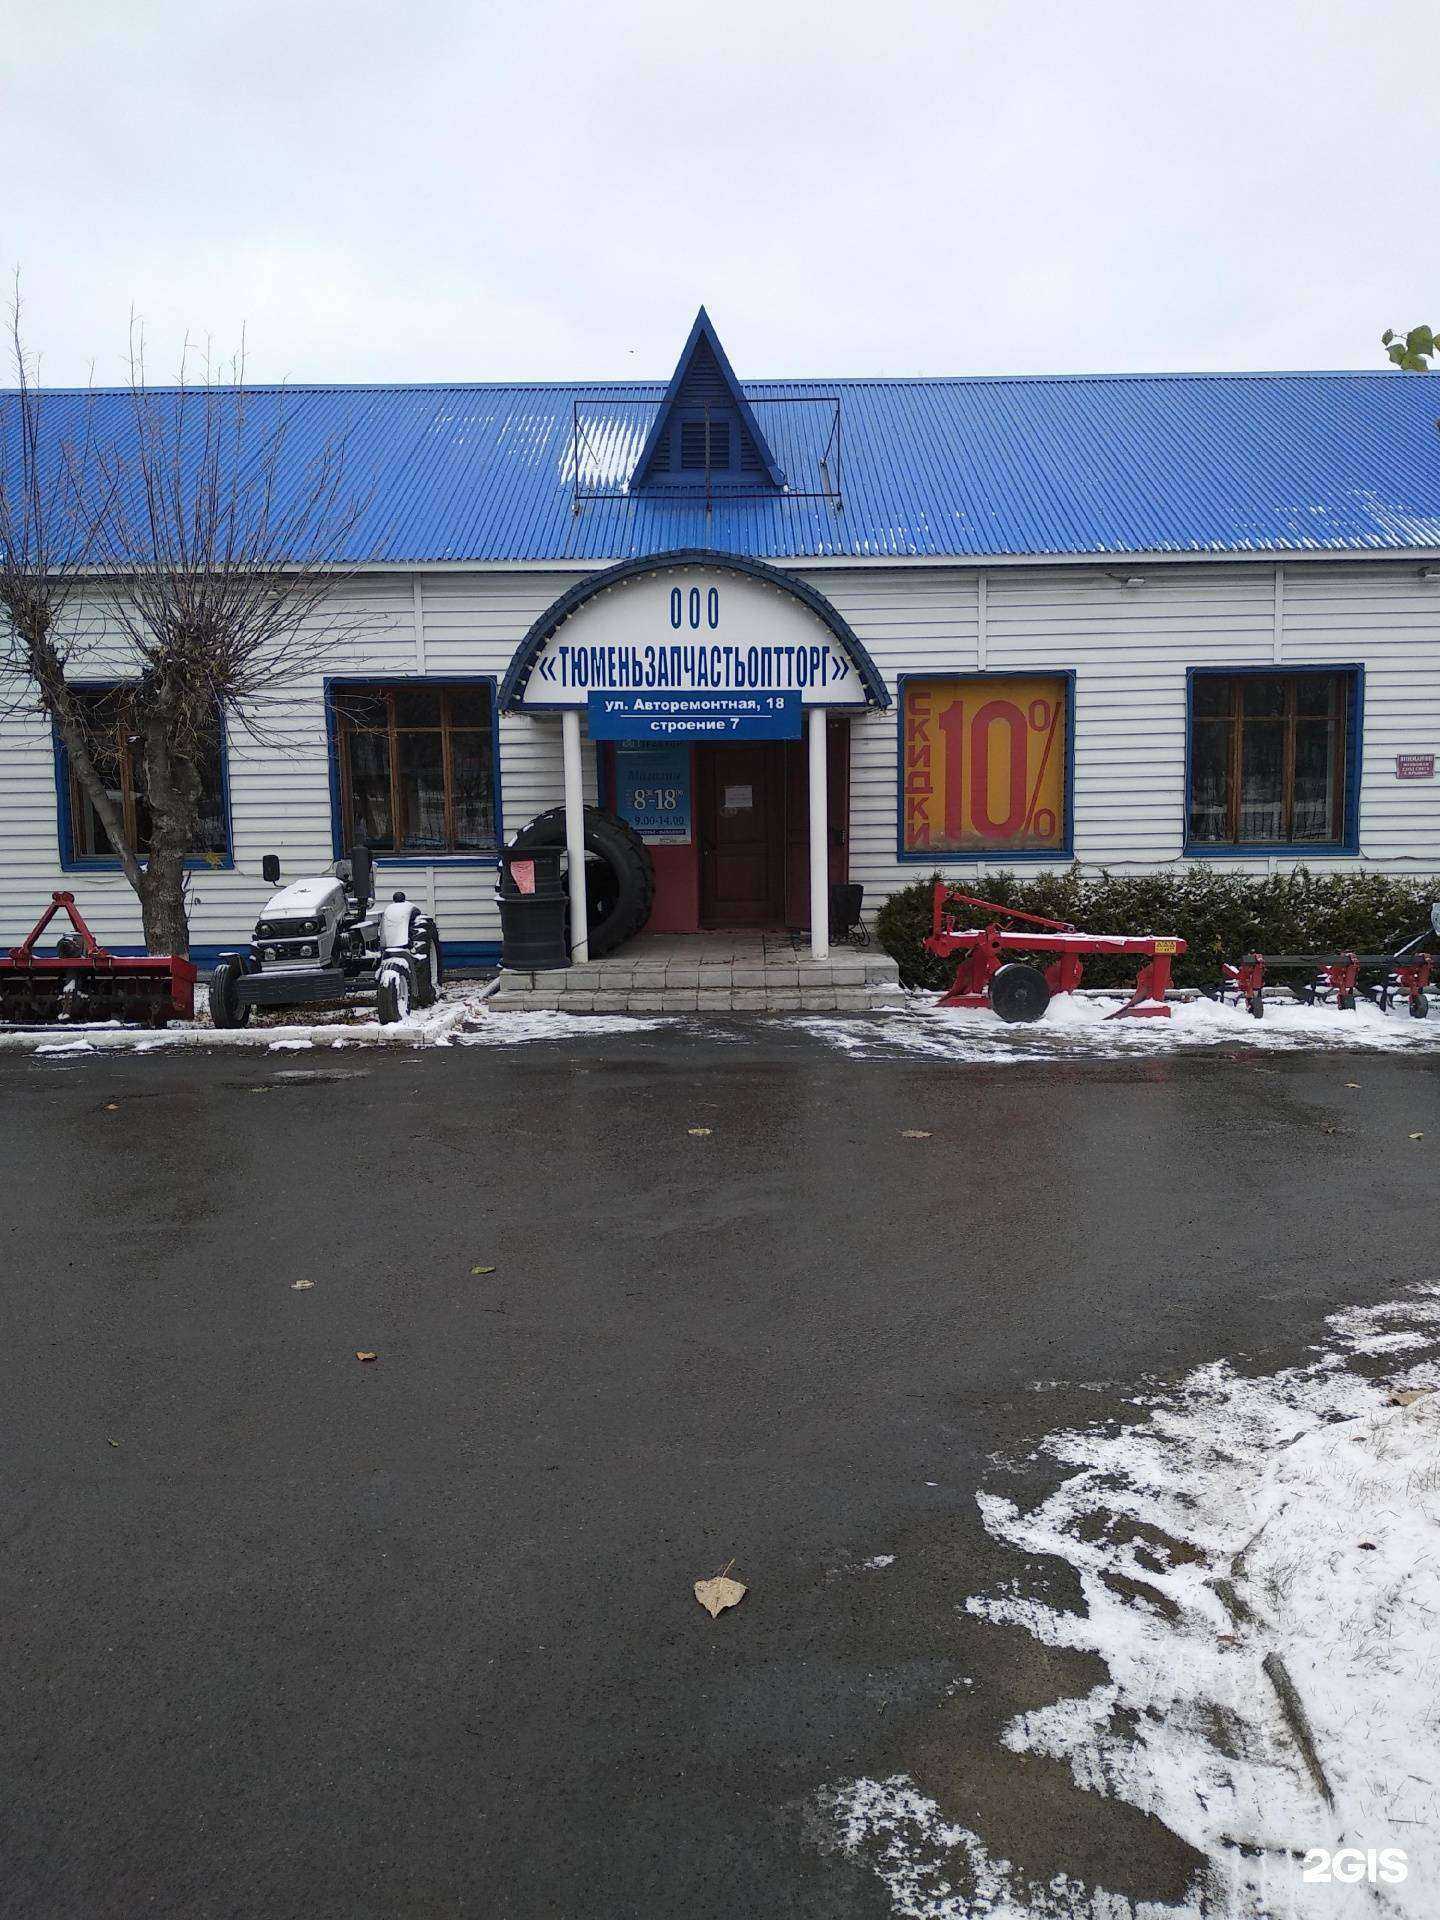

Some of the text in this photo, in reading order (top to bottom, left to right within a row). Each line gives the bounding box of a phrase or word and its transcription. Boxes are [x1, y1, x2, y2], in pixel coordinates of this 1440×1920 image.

[669, 587, 720, 630] ООО
[538, 645, 850, 687] «ТЮМЕНЬЗАПЧАСТЬОПТТОРГ»
[605, 697, 785, 713] ул. Авторемонтная, 18
[650, 718, 740, 733] строение 7
[906, 692, 934, 847] СКИДКИ
[938, 699, 1064, 843] 10%
